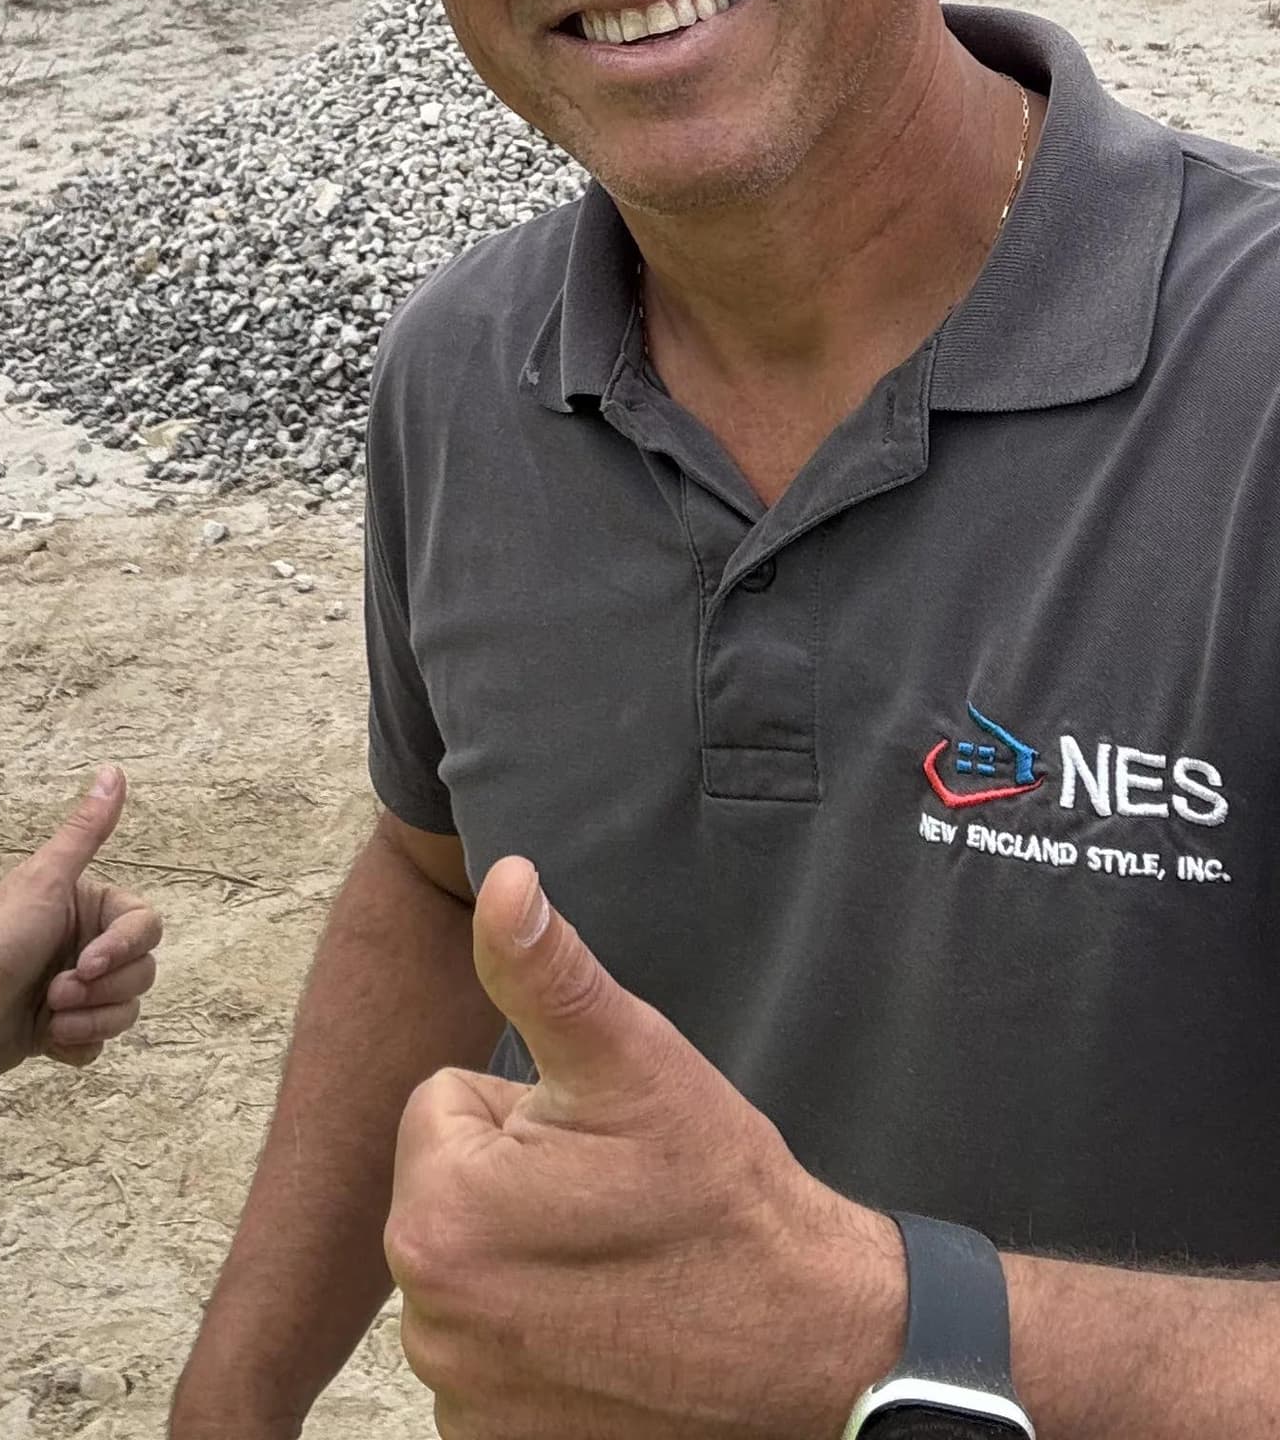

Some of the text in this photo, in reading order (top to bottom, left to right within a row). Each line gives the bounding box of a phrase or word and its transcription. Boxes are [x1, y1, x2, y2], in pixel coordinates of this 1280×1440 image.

[1059, 735, 1229, 827] NES
[919, 812, 1231, 883] NEW ENGLAND STYLE, INC.
